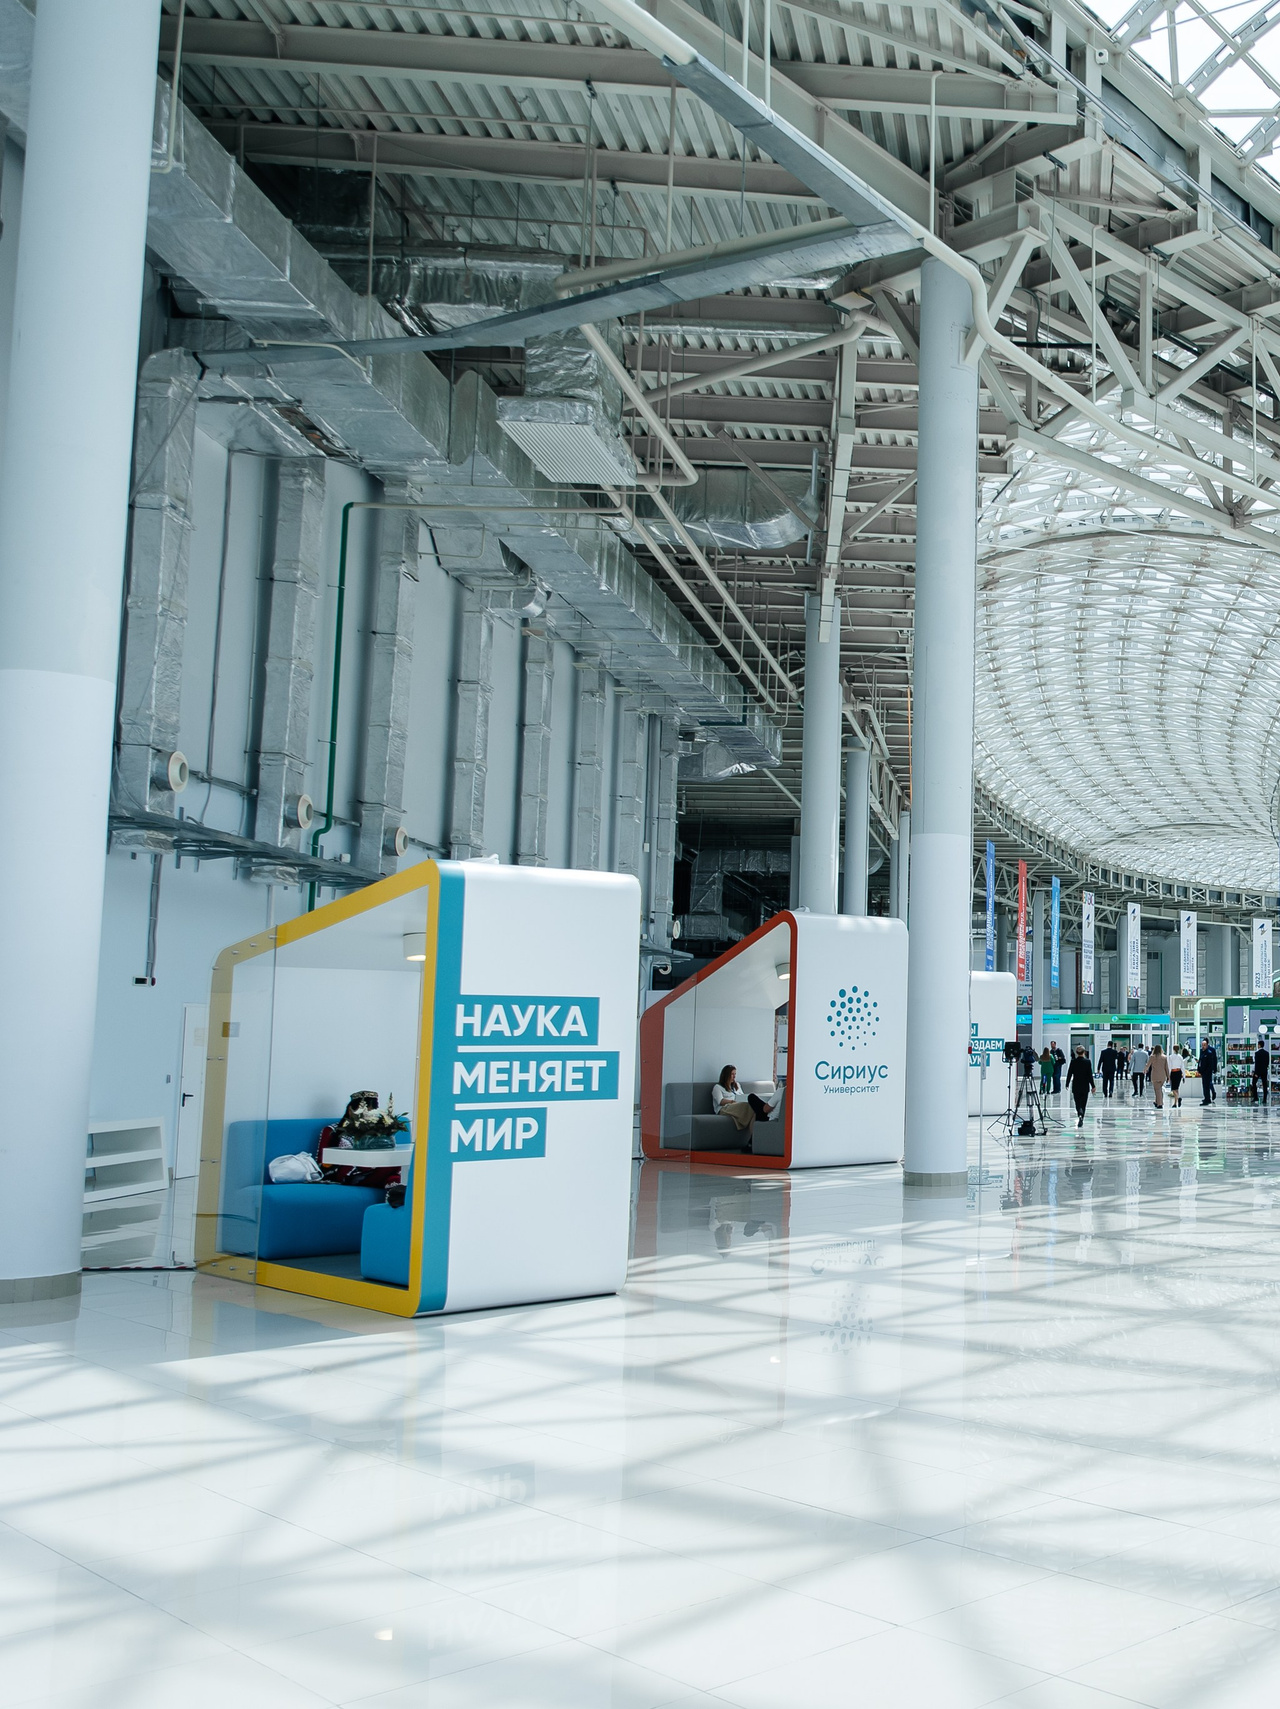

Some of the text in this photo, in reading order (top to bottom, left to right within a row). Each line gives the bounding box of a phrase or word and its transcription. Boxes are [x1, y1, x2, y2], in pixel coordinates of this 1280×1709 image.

[455, 1004, 588, 1037] НАУКА
[453, 1060, 607, 1094] МЕНЯЕТ
[815, 1061, 888, 1084] Сириус
[824, 1085, 880, 1095] Университет
[450, 1117, 539, 1153] МИР
